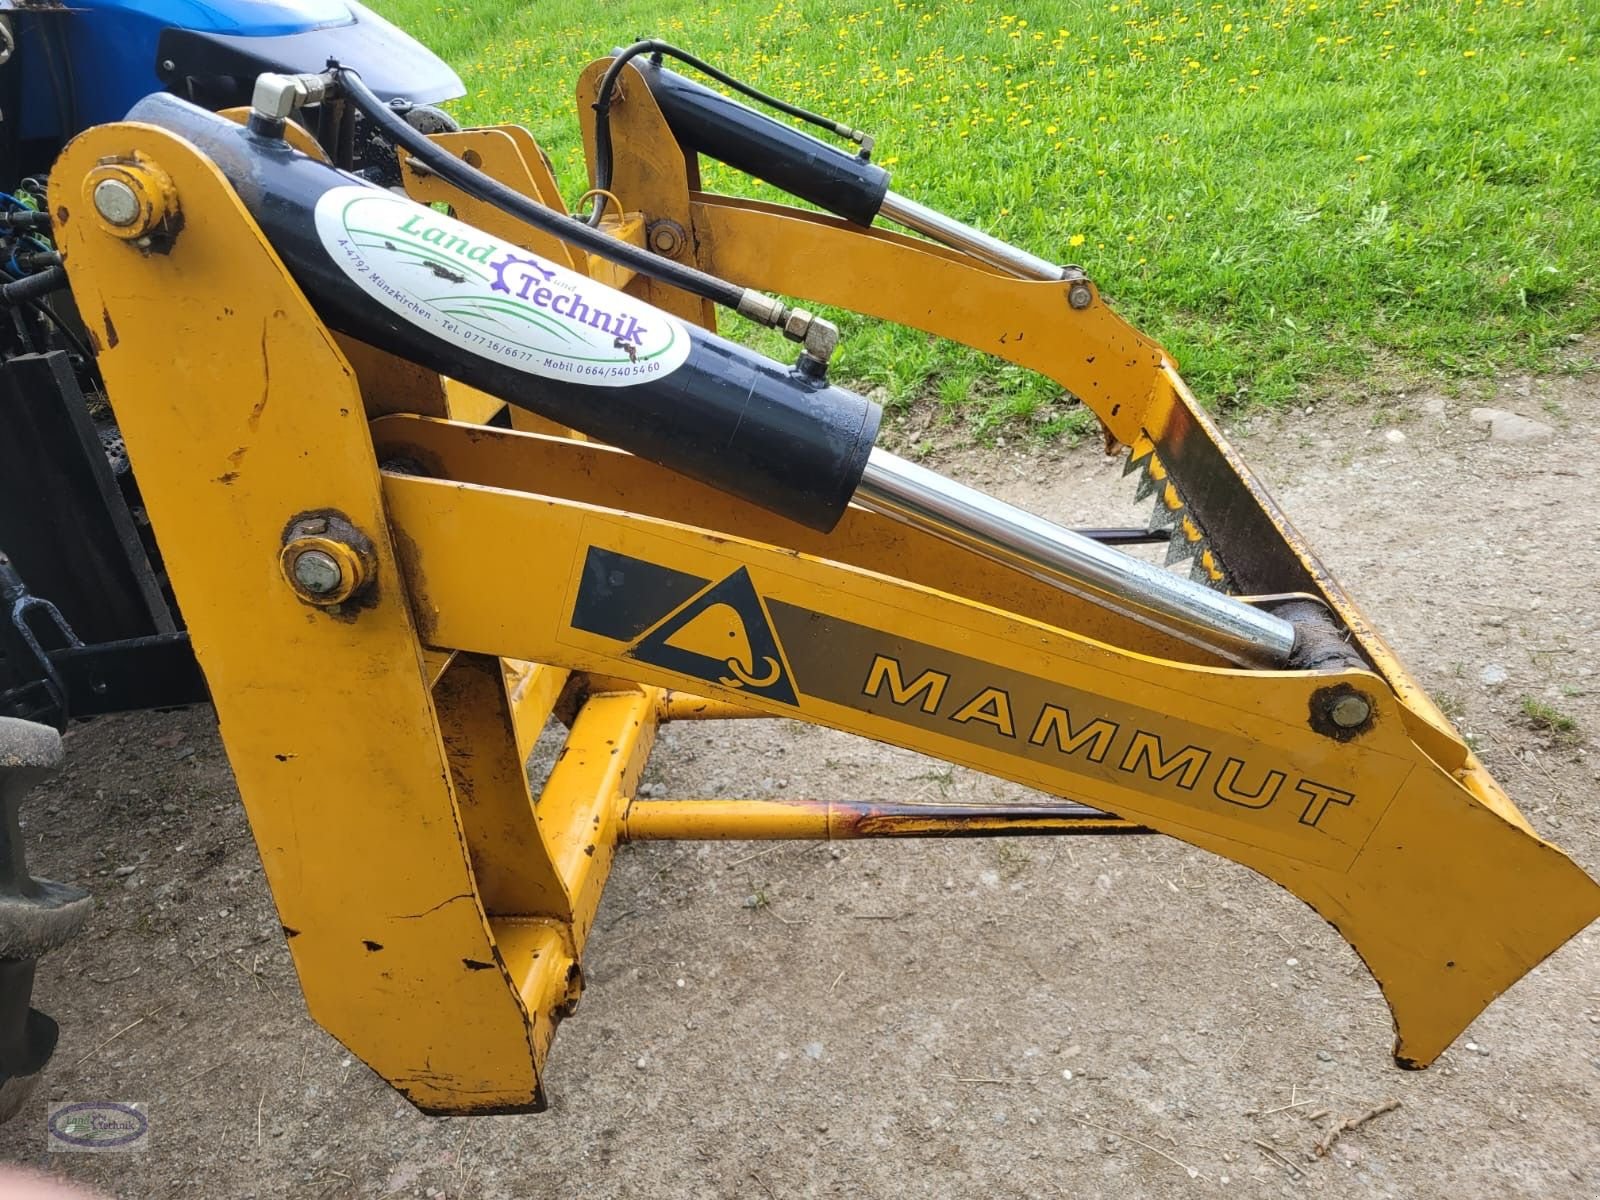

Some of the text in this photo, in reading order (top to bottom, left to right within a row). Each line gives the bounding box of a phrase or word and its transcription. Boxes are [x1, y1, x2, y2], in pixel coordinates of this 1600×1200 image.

[396, 213, 498, 265] Land
[338, 239, 370, 272] A-4792
[368, 272, 432, 320] Münzkirchen
[441, 319, 460, 335] Tel.
[543, 358, 573, 372] Mobil
[515, 273, 648, 347] Technik
[862, 653, 1355, 827] MAMMUT
